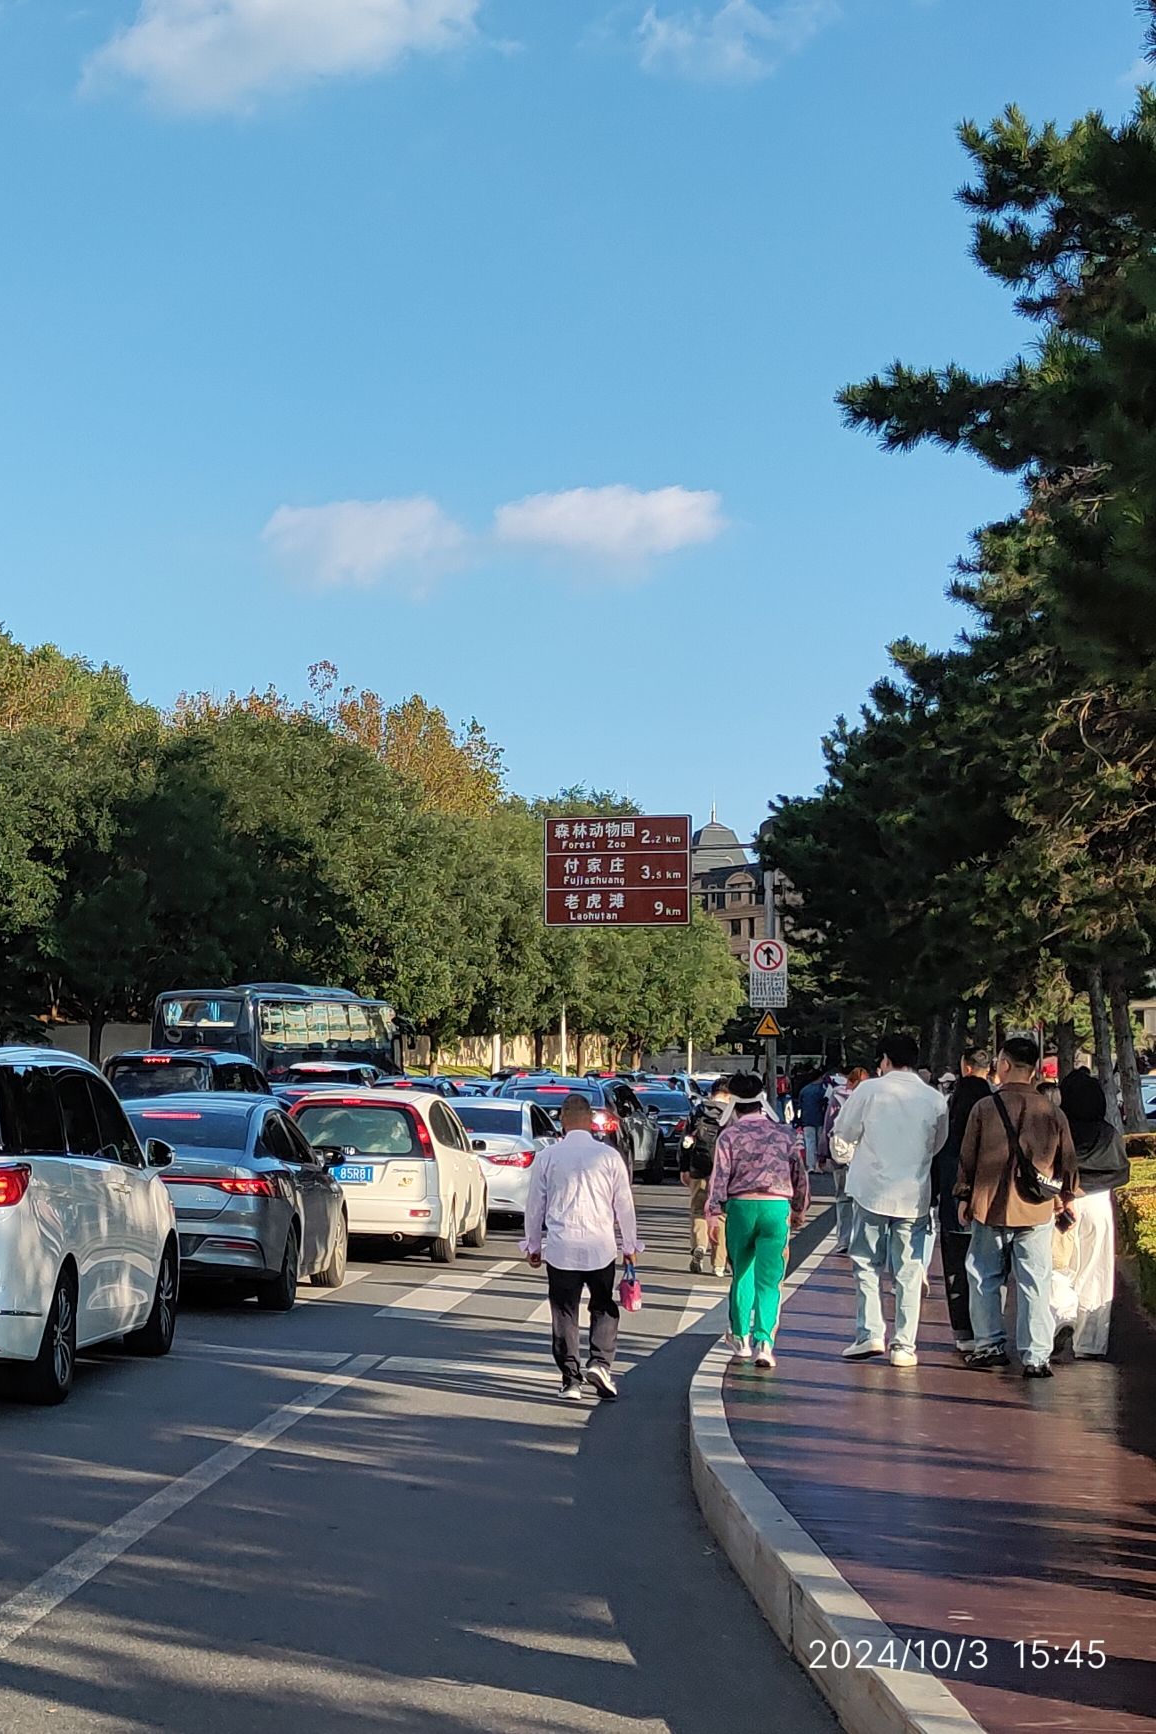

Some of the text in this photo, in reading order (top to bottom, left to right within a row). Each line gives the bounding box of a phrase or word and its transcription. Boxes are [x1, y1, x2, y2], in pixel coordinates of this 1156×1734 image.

[554, 822, 635, 838] 森林动物园
[641, 829, 681, 844] 2.2 km
[561, 840, 626, 849] Forest Zoo
[564, 857, 625, 873] 付家庄
[640, 865, 681, 880] 3.5 km
[563, 876, 625, 886] Fujiazhuang
[564, 893, 625, 909] 老虎滩
[654, 901, 681, 916] 9 km
[570, 911, 618, 921] Laohutan
